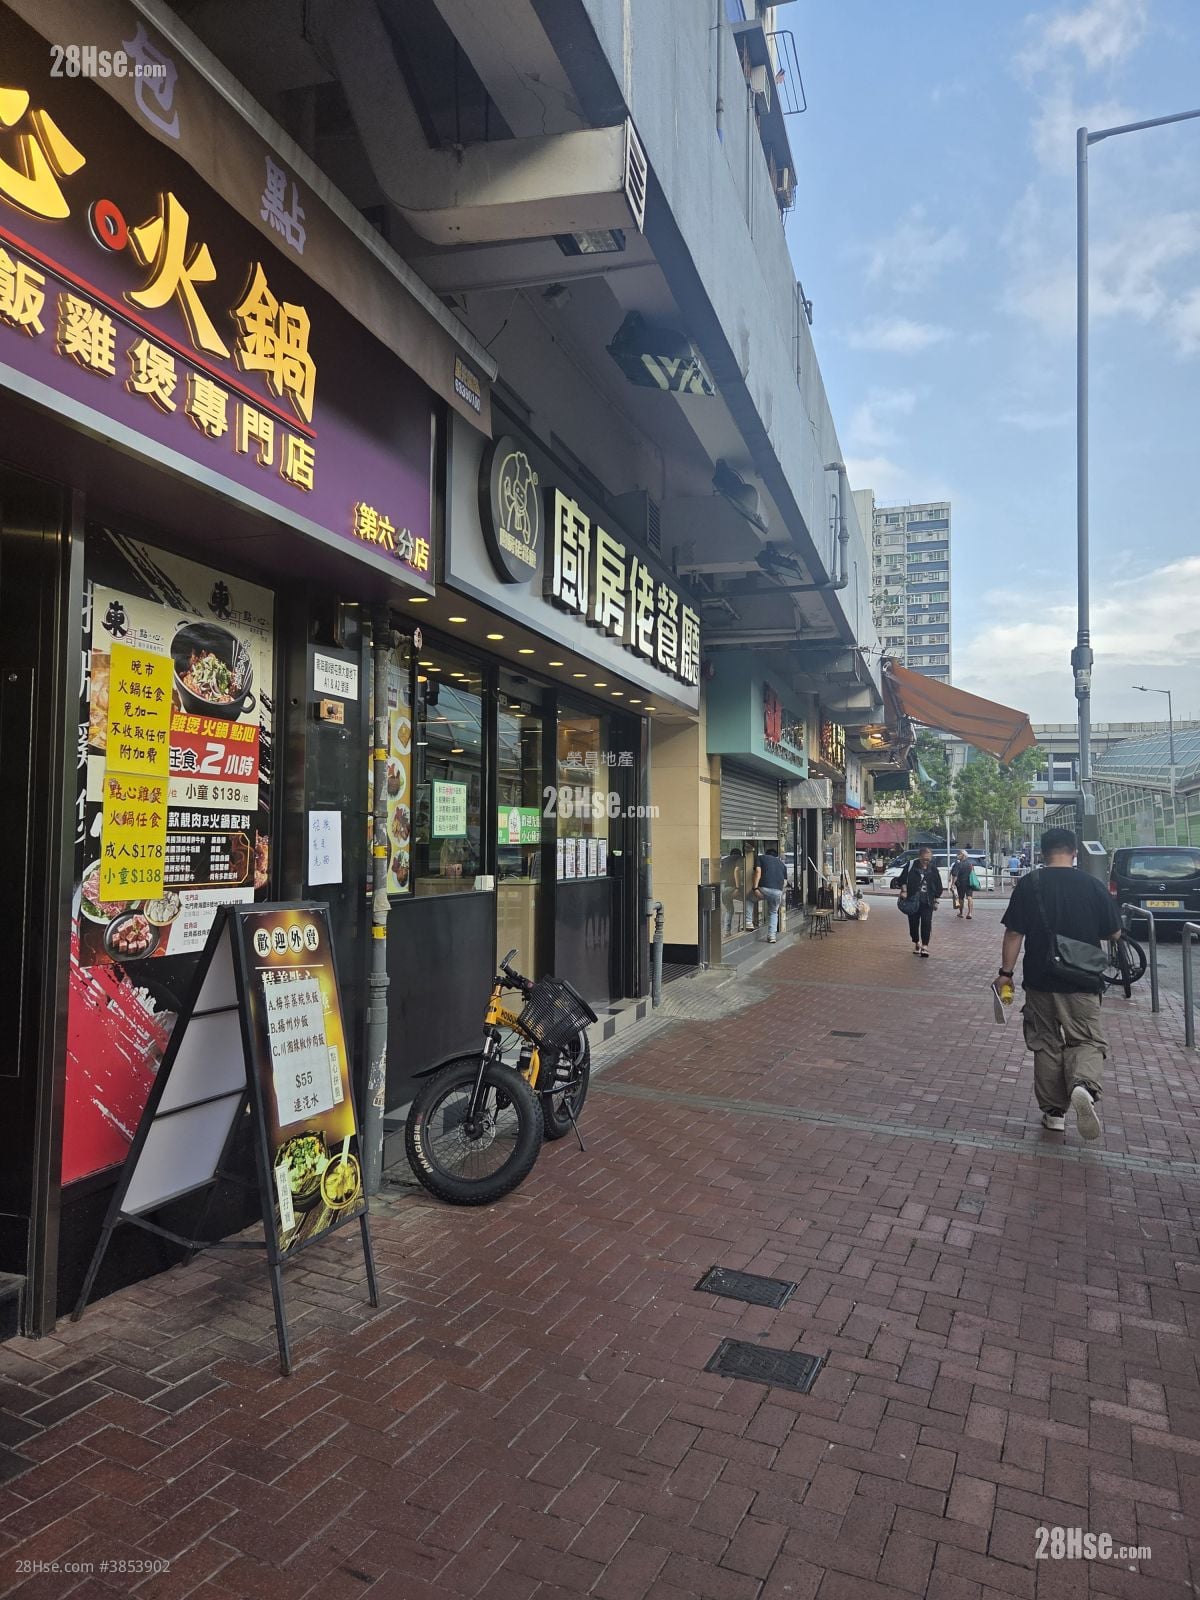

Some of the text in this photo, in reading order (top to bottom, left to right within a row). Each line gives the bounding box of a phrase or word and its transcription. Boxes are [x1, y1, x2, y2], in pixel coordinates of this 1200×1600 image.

[354, 501, 430, 572] 第六分店
[131, 660, 155, 677] 晚市
[118, 680, 165, 702] 火鍋任食
[123, 702, 158, 717] 免加一
[111, 722, 167, 744] 不收取任何
[171, 714, 256, 743] 雞煲 火鍋 點心
[120, 744, 158, 764] 附加費
[109, 810, 162, 828] 火鍋任食
[105, 842, 163, 859] 成人$178
[104, 867, 161, 885] 小童$138
[257, 929, 317, 952] 歡迎外賣
[295, 1071, 313, 1089] $55
